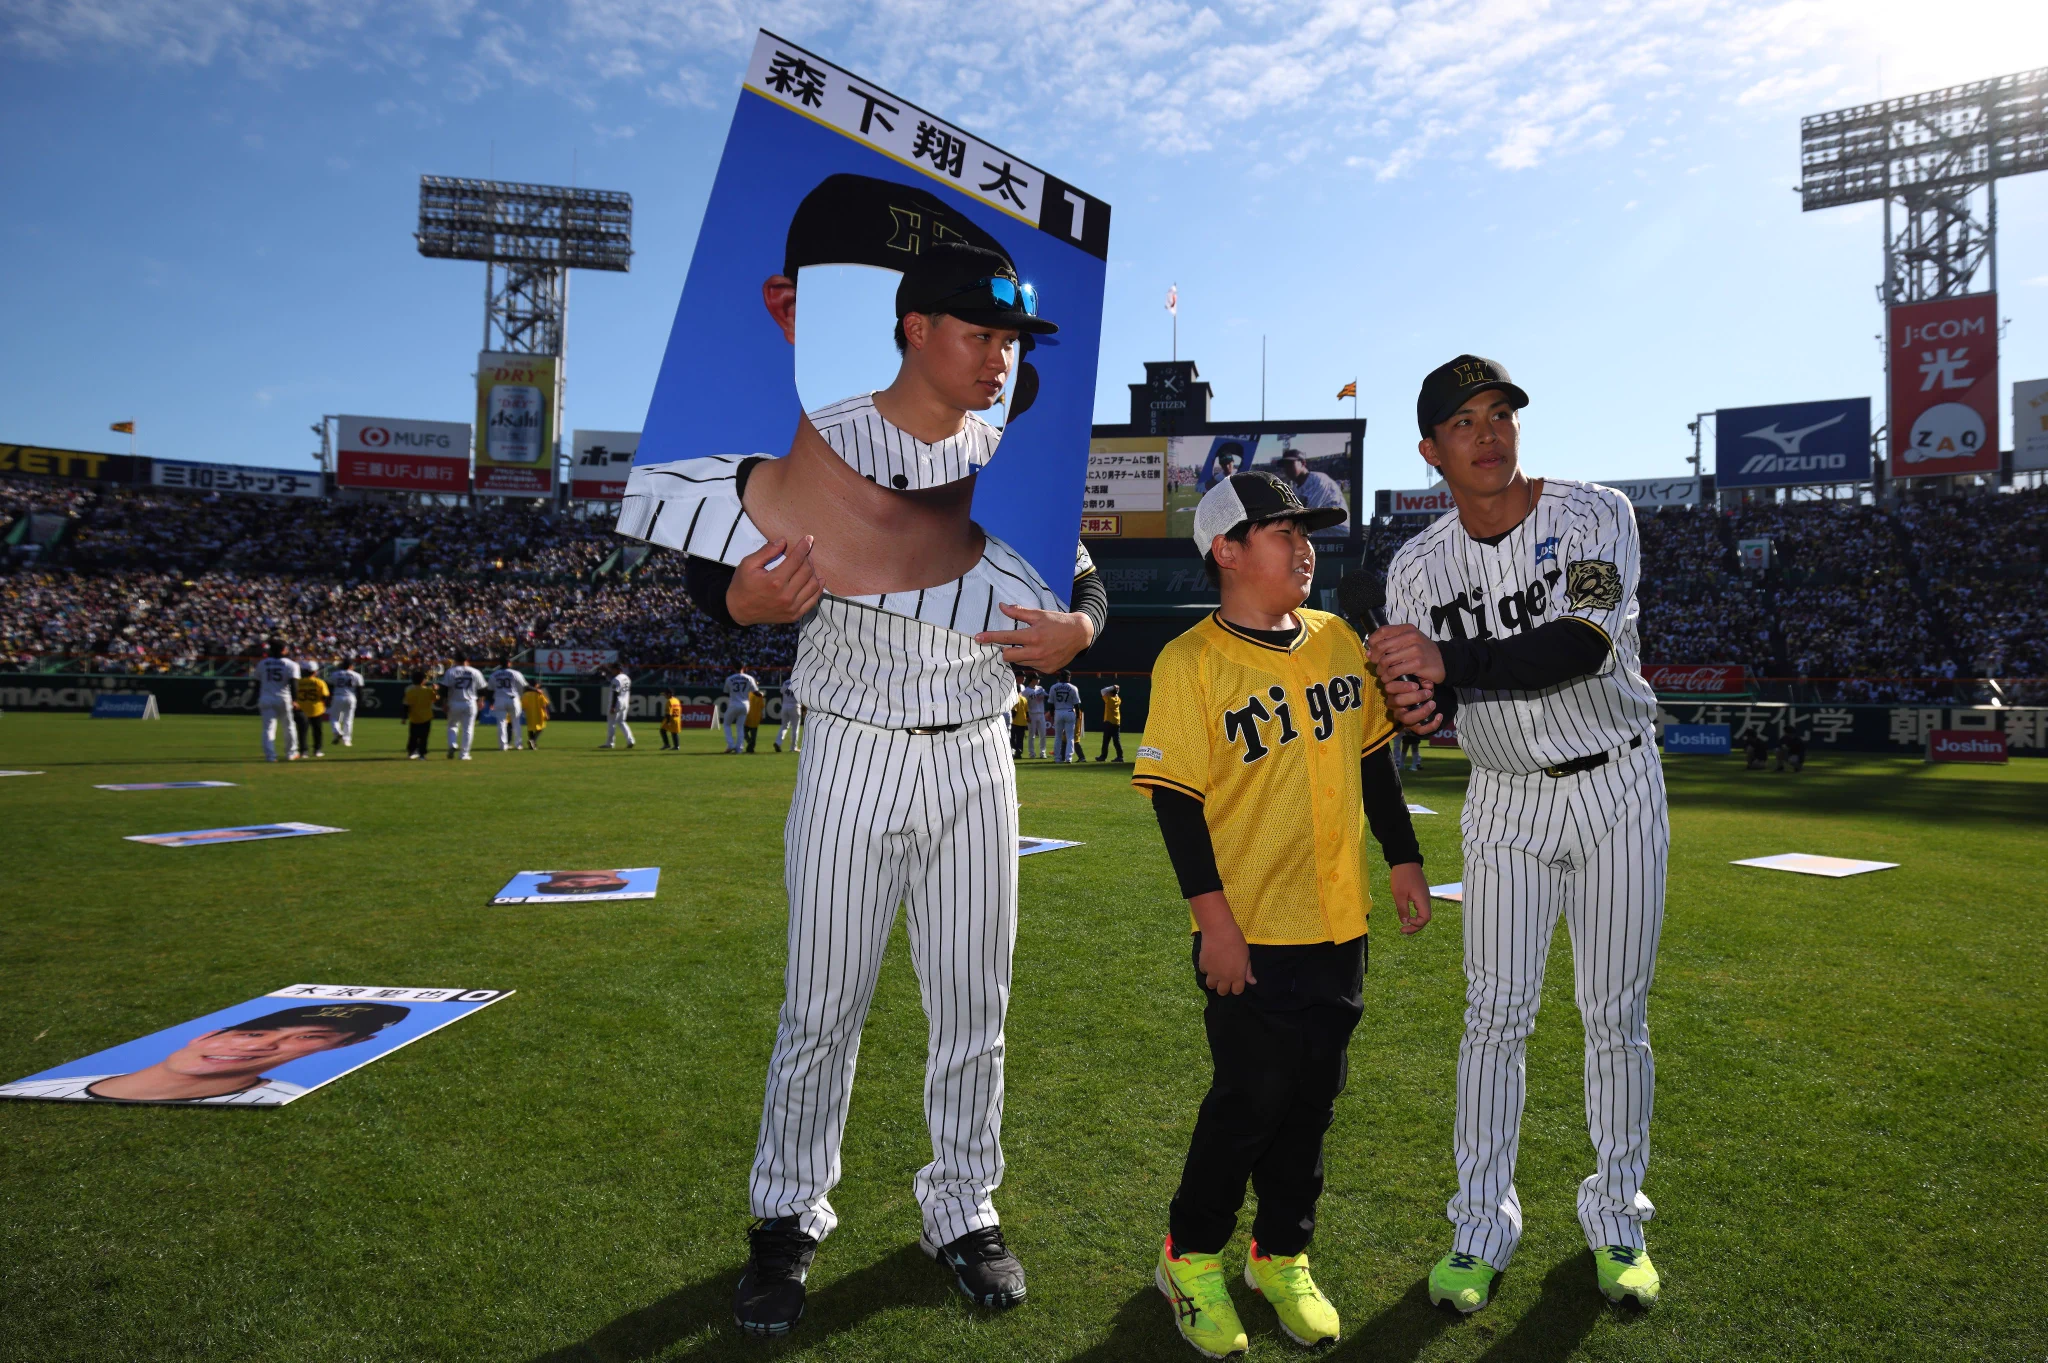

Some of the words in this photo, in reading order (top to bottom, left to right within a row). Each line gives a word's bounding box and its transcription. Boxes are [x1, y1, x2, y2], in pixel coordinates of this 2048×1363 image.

[765, 50, 1028, 210] 森下翔太
[1919, 347, 1976, 392] 光
[1150, 401, 1187, 409] CITIZEN
[490, 409, 539, 428] Asahi
[394, 432, 450, 448] MUFG
[580, 446, 637, 466] ホー
[1739, 454, 1846, 474] MIZUNO
[352, 461, 453, 480] 三菱UFJ銀行
[162, 465, 312, 494] 三和シャッター
[265, 667, 284, 682] 15
[455, 677, 473, 690] 27
[732, 682, 748, 694] 37
[1056, 692, 1070, 703] 57
[679, 709, 712, 721] oshin
[1669, 732, 1726, 746] Joshin
[1936, 738, 2002, 754] Joshin
[285, 985, 448, 999] 木浪聖也
